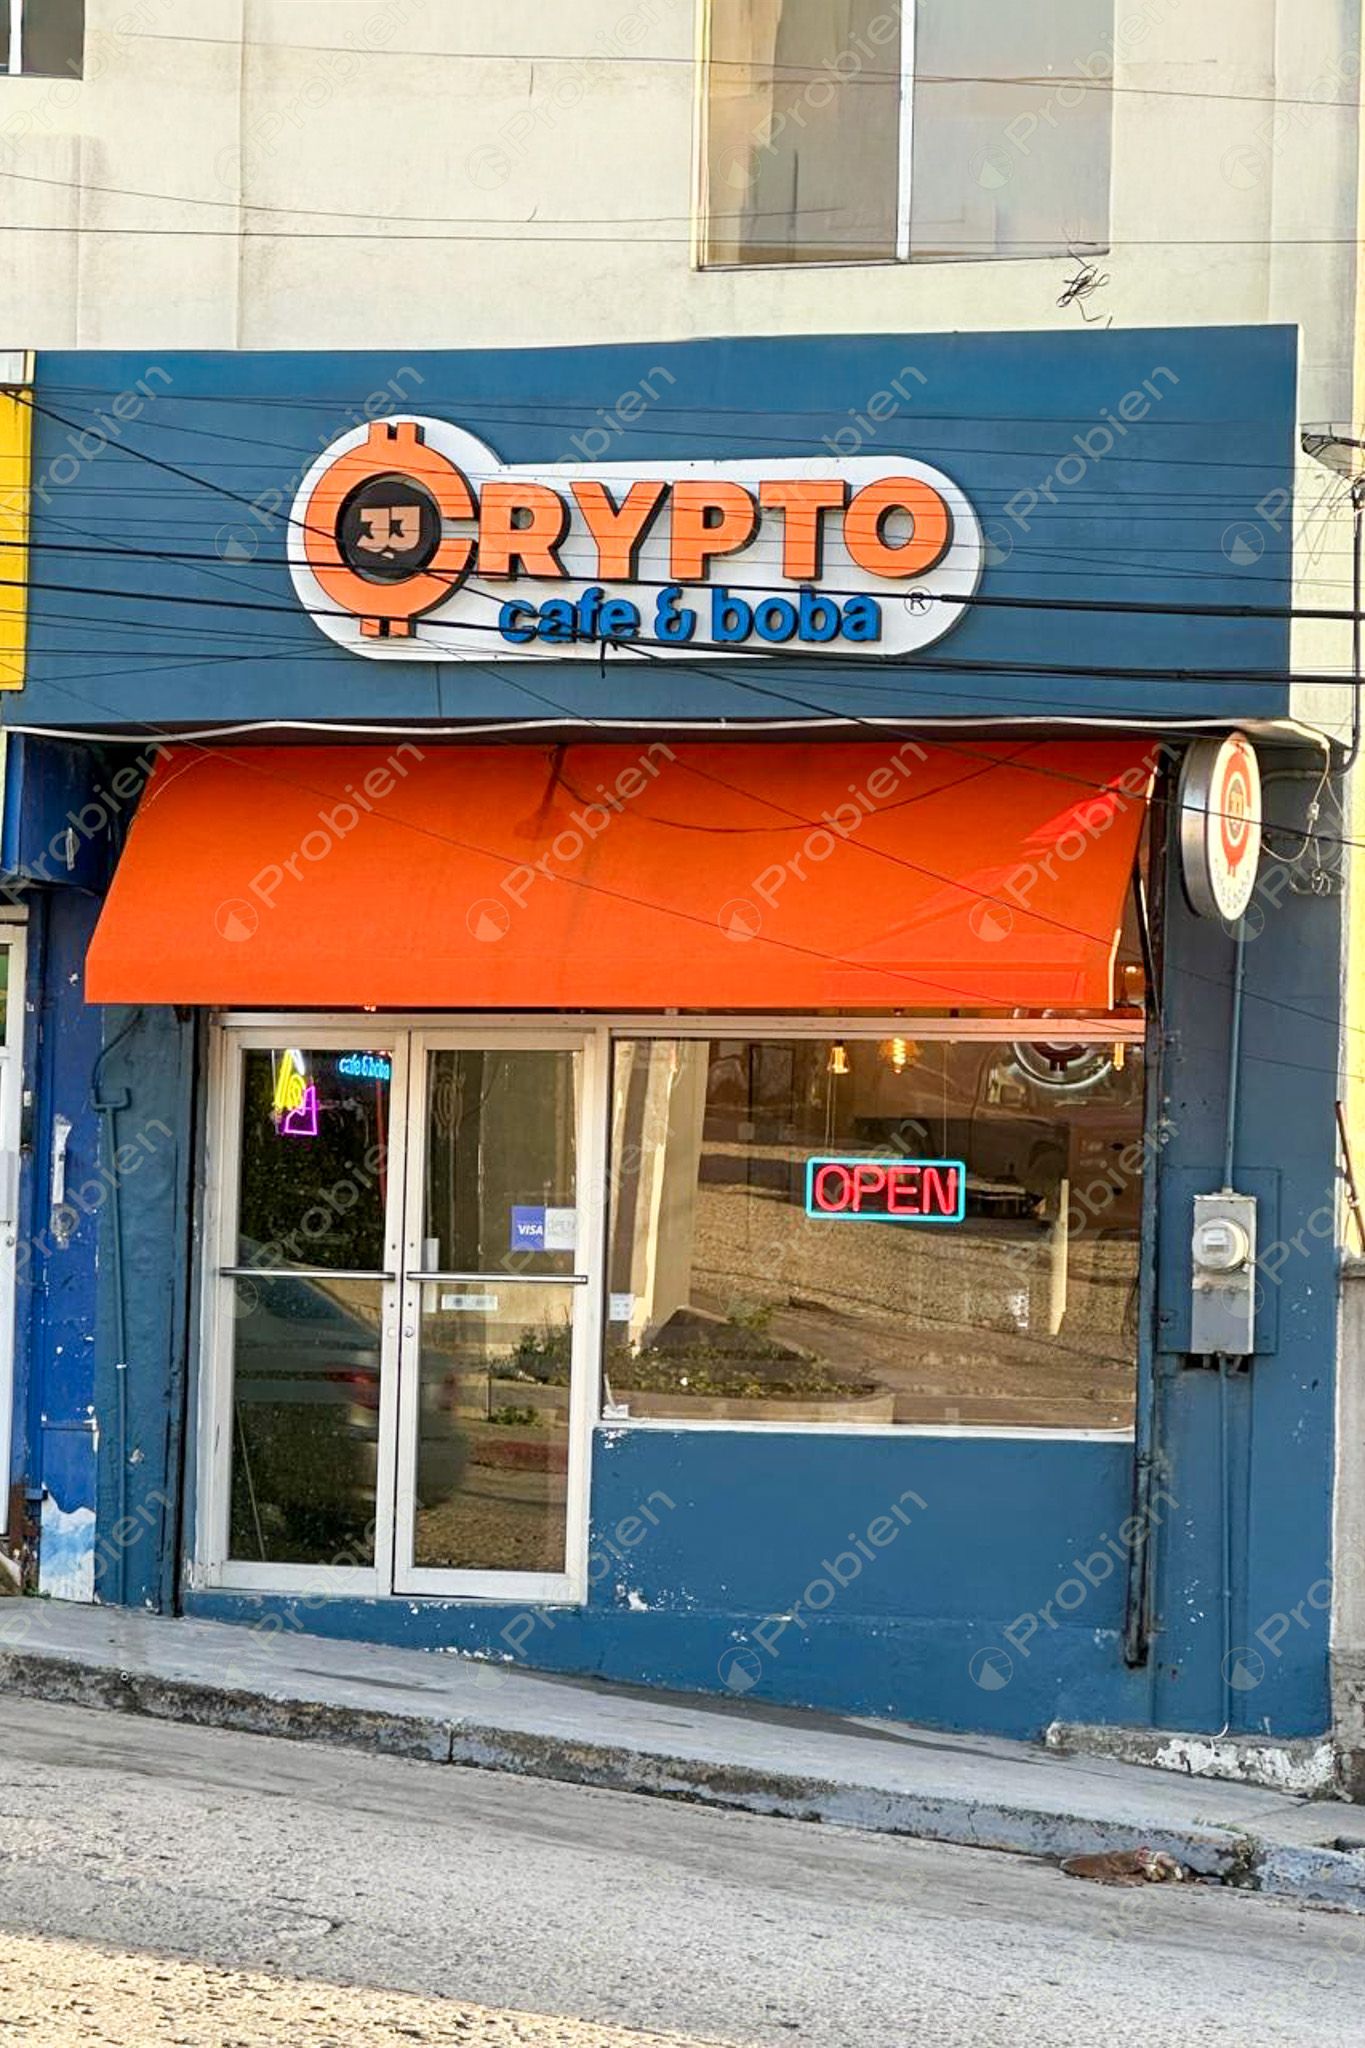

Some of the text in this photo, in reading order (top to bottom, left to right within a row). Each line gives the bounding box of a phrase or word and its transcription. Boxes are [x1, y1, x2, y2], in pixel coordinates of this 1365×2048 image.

[304, 422, 955, 638] CRYPTO
[499, 586, 640, 643] cafe
[654, 585, 697, 643] &
[711, 585, 883, 643] boba
[815, 1164, 957, 1215] OPEN
[518, 1224, 543, 1236] VISA
